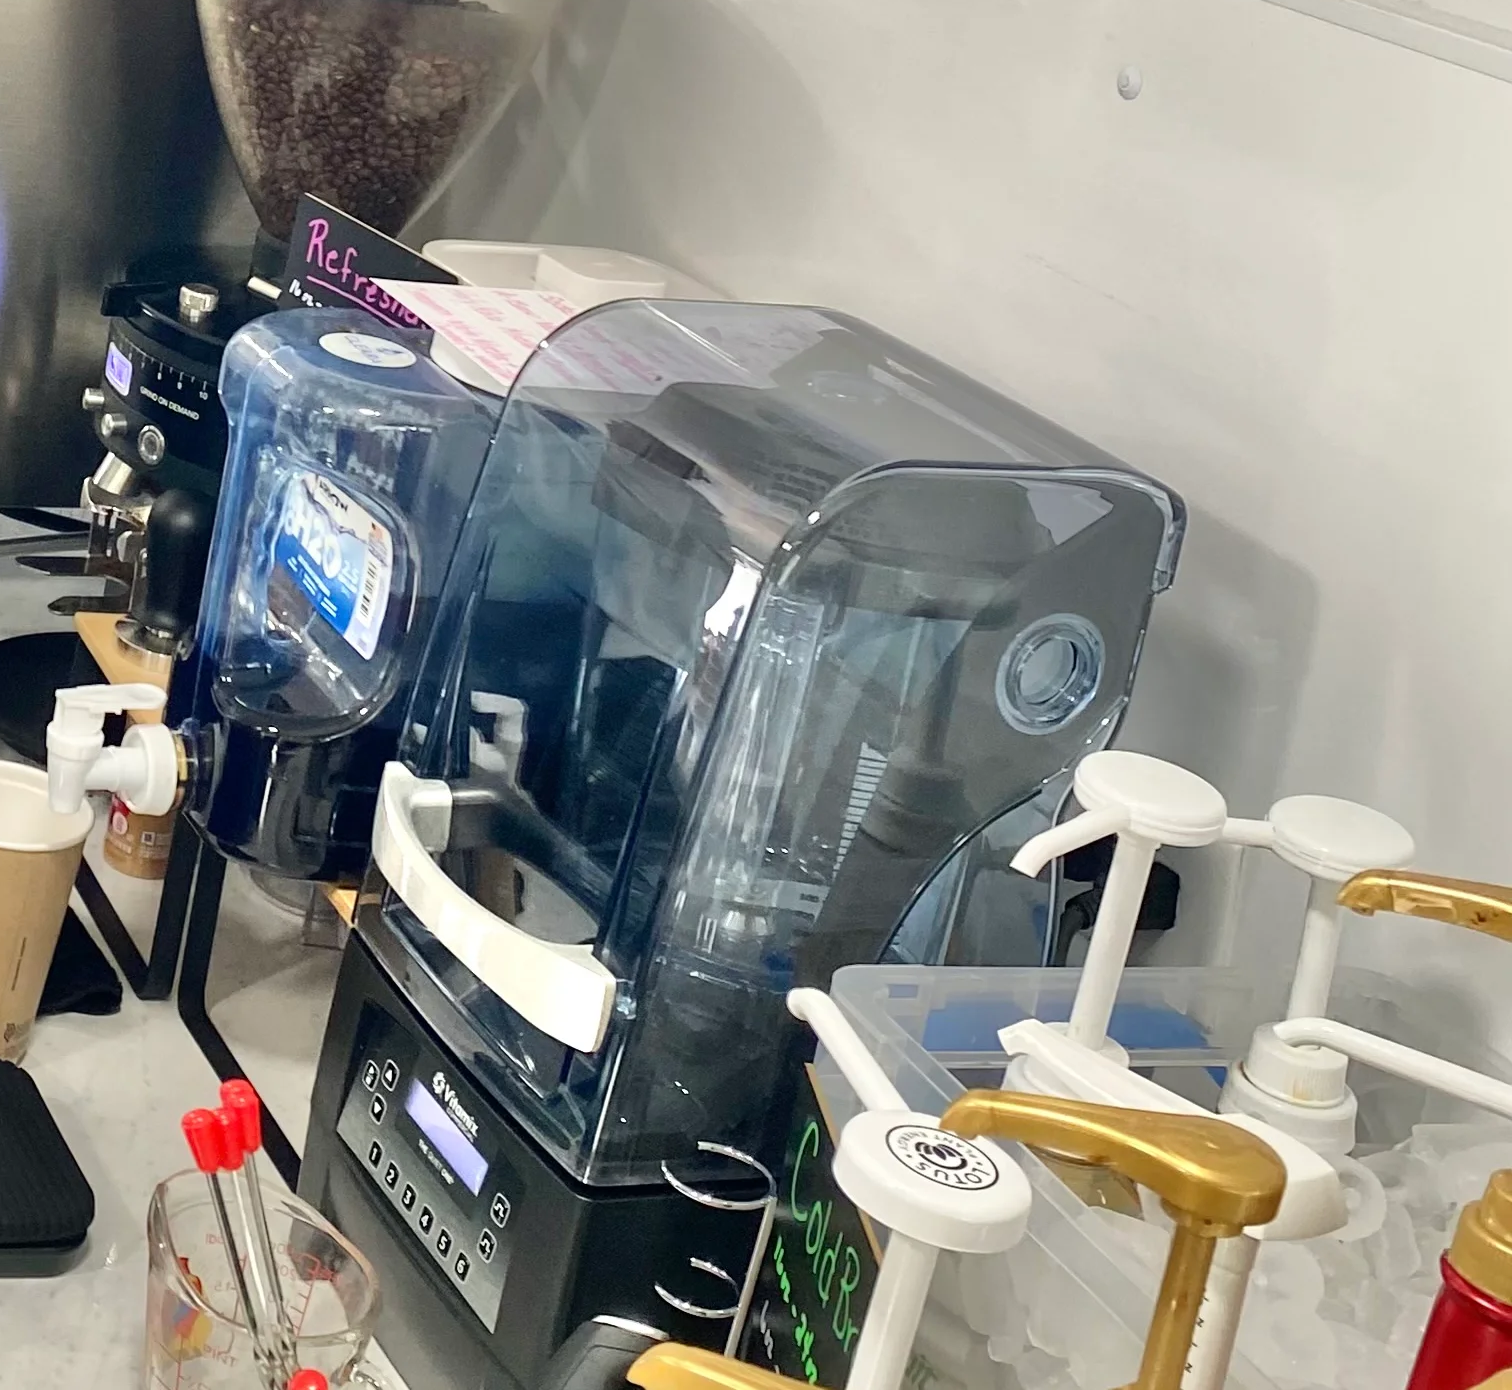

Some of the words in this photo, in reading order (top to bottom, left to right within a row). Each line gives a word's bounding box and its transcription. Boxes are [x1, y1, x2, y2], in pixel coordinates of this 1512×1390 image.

[157, 396, 168, 407] ON
[168, 401, 200, 420] DEMAND
[445, 1084, 478, 1137] Vitamix
[915, 1161, 990, 1185] LOTUS
[371, 1147, 378, 1161] 1
[386, 1168, 395, 1183] 2
[403, 1191, 412, 1205] 3
[420, 1214, 429, 1228] 4
[438, 1236, 448, 1250] 5
[456, 1259, 465, 1274] 6
[791, 1121, 843, 1308] Cold
